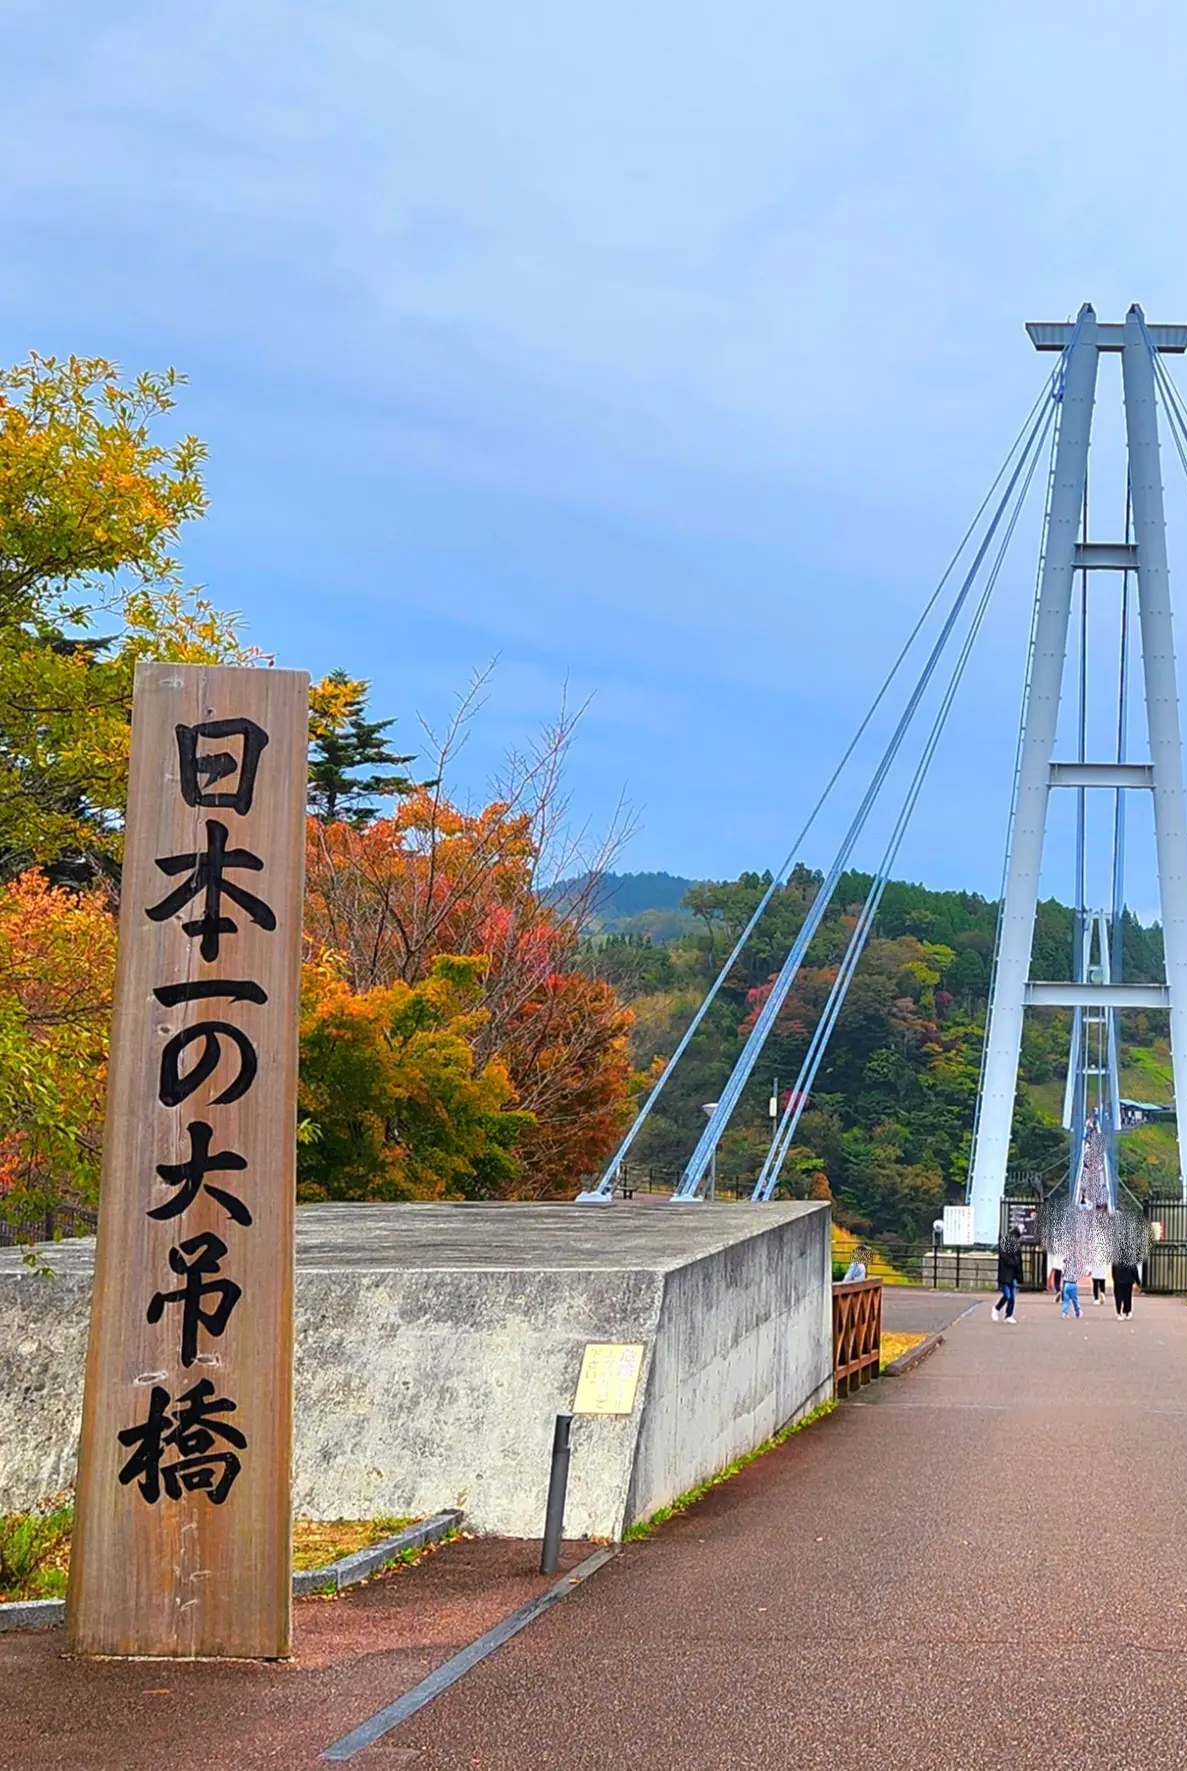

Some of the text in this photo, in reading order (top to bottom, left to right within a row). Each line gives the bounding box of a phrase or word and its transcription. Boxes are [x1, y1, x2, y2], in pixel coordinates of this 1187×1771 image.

[118, 718, 276, 1505] 日本一の大吊橋
